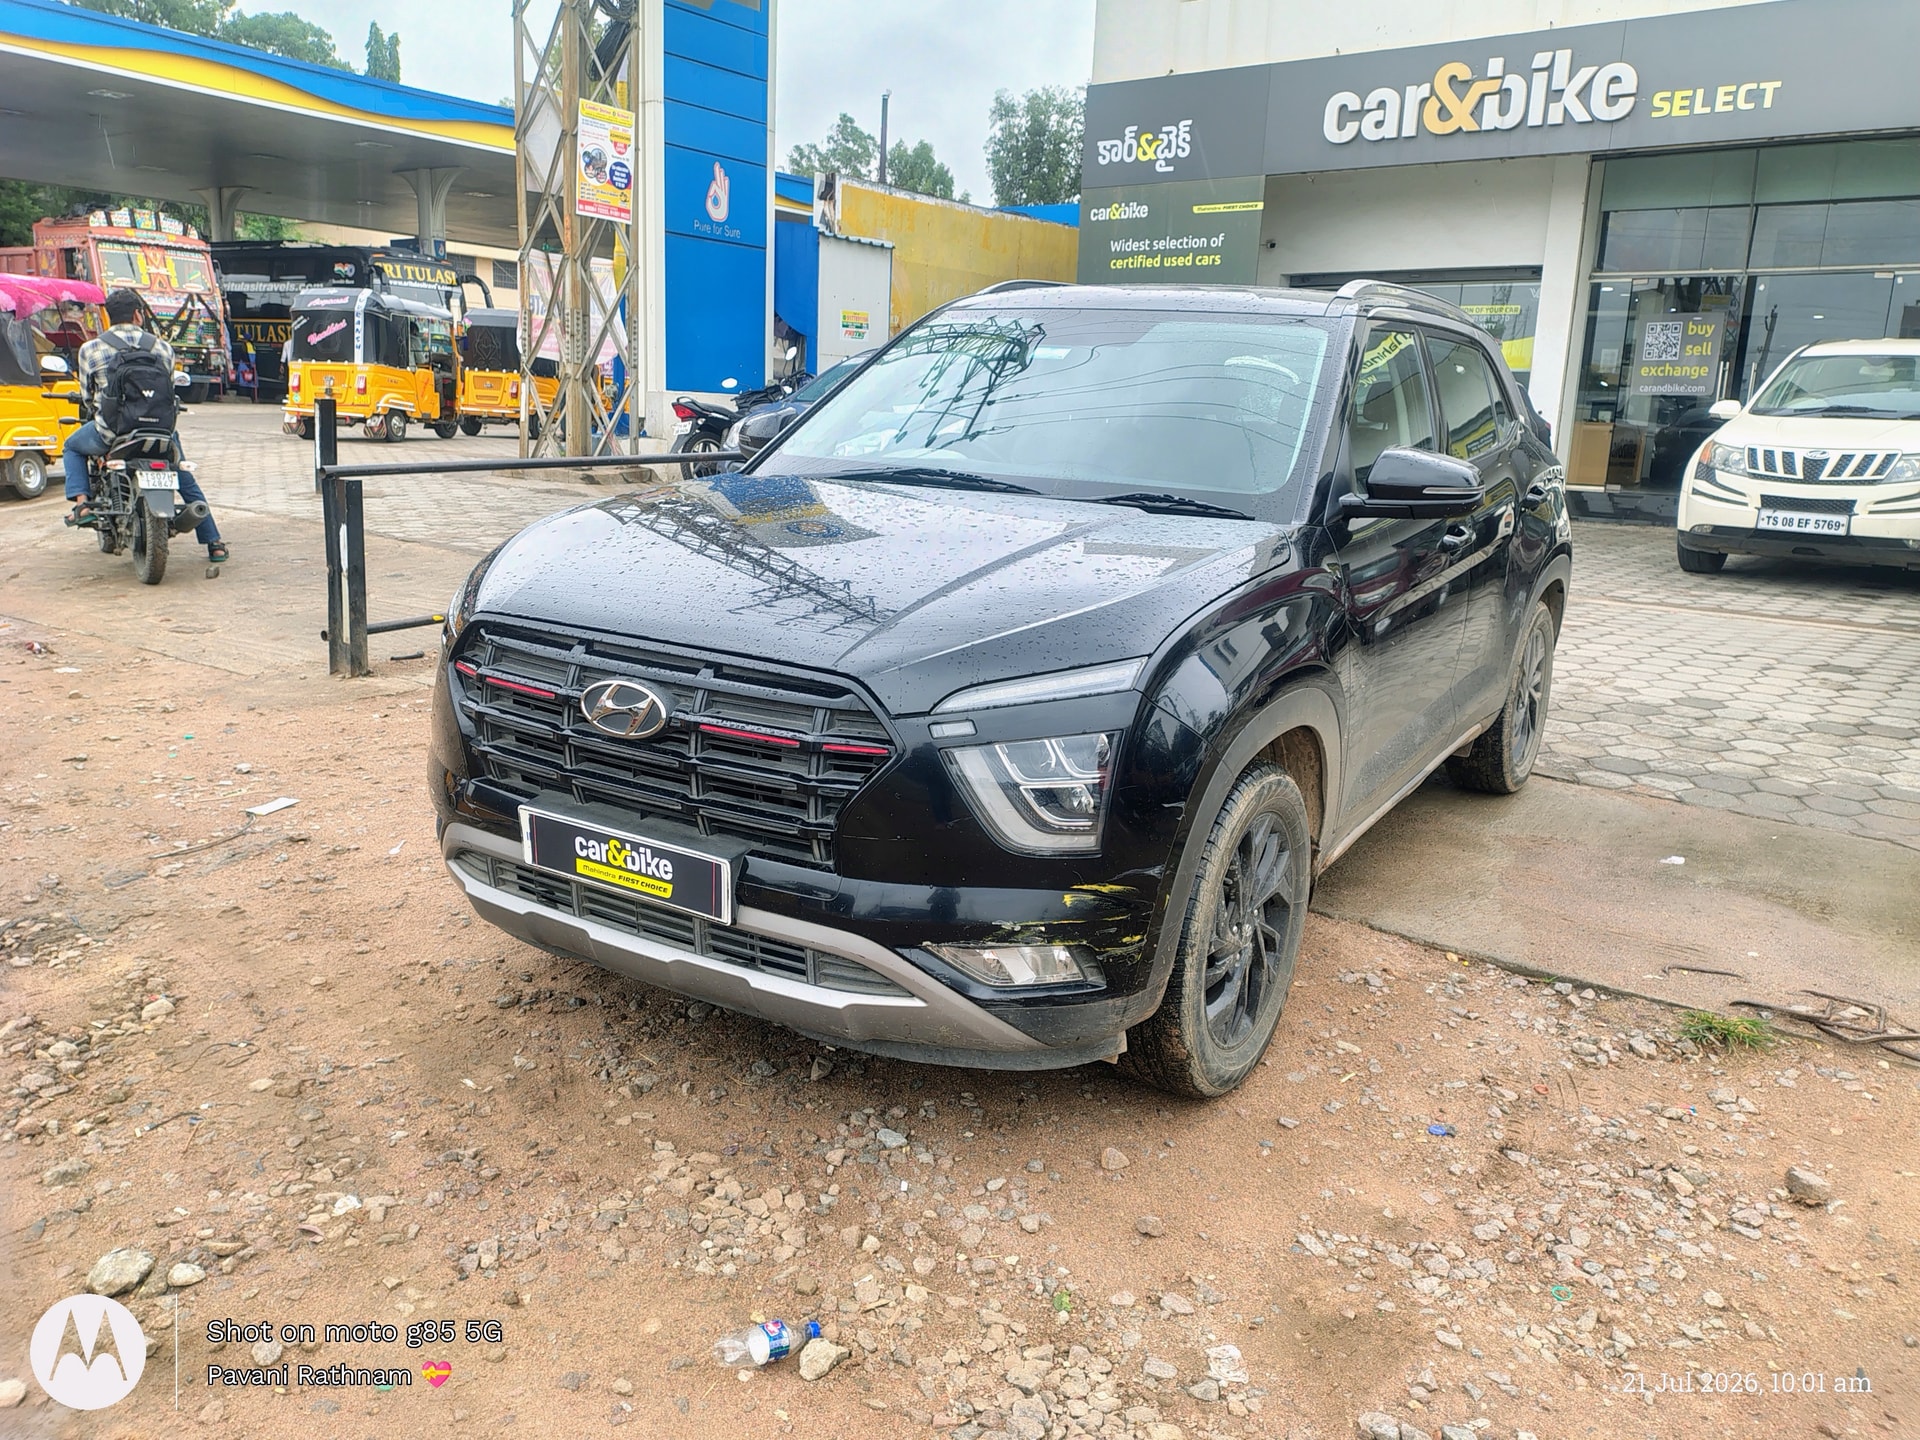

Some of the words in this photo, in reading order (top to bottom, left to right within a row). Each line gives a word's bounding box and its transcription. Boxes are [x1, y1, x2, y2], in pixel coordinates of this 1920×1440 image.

[1323, 49, 1638, 144] car&bike
[1650, 80, 1783, 119] SELECT
[1090, 202, 1149, 221] car&bike
[694, 219, 711, 233] Pure
[713, 223, 723, 235] for
[724, 225, 741, 239] Sure
[1110, 239, 1150, 252] Widest
[1152, 236, 1207, 250] selection
[1210, 233, 1225, 247] of
[1110, 255, 1161, 269] certified
[1163, 253, 1193, 267] used
[1195, 254, 1221, 265] cars
[374, 261, 402, 279] RI
[403, 265, 458, 286] TULASI
[234, 324, 292, 343] TULASI
[1687, 321, 1715, 338] buy
[1685, 341, 1712, 356] sell
[1640, 362, 1709, 380] exchange
[1639, 383, 1706, 393] carandbike.com
[1766, 516, 1779, 526] TS
[1781, 516, 1795, 528] 08
[1797, 518, 1811, 529] EF
[1814, 519, 1841, 531] 5769
[575, 836, 673, 881] car&bike
[618, 875, 639, 886] FIRST
[640, 881, 669, 894] CHOICE
